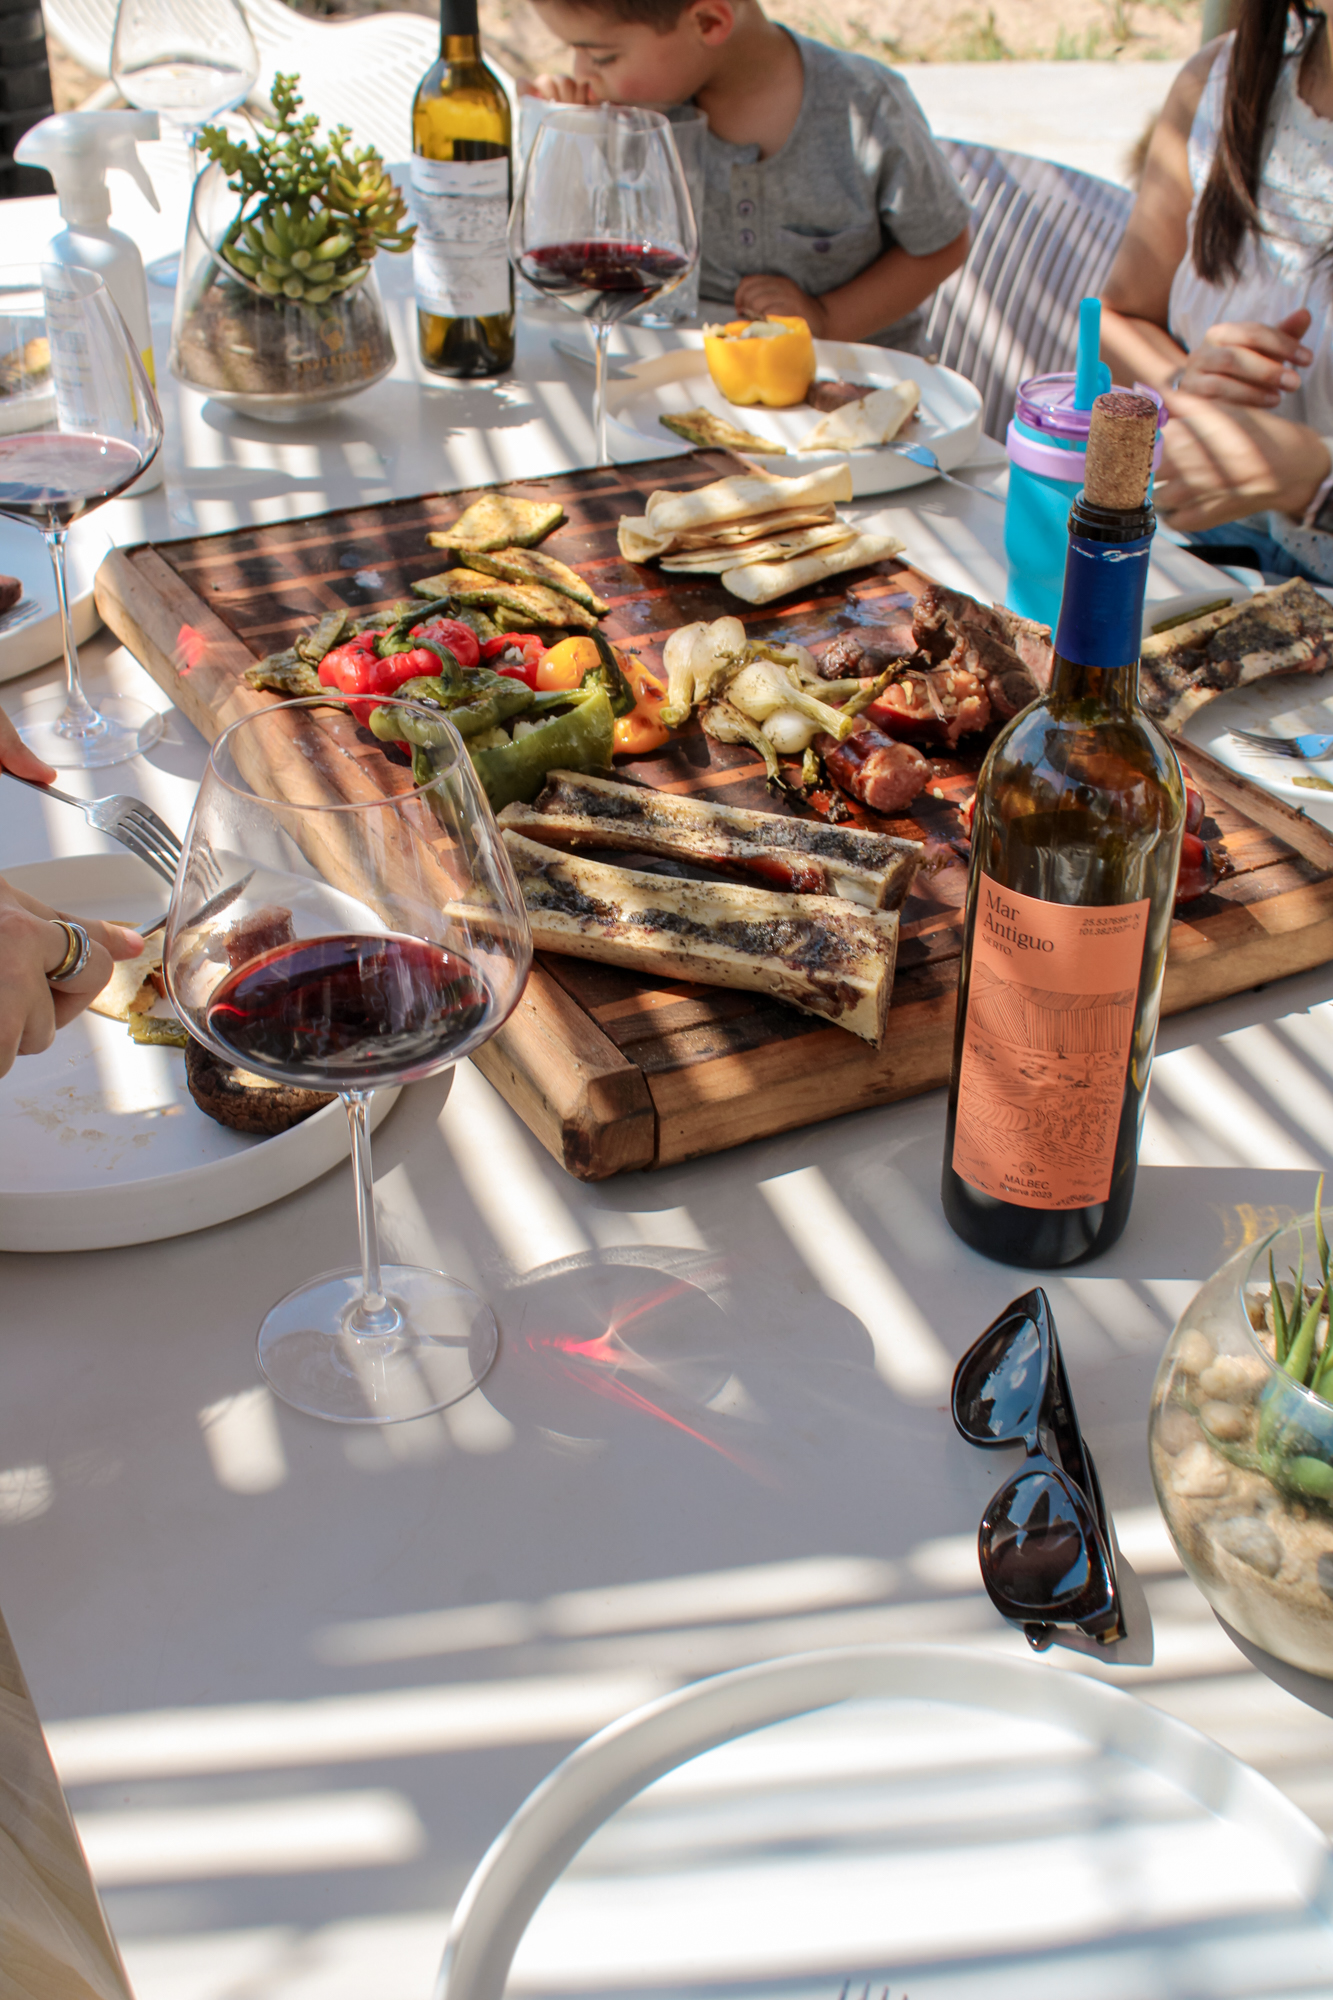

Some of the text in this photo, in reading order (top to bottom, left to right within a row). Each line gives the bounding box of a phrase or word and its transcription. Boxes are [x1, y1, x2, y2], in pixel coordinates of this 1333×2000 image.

[985, 889, 1020, 922] Mar
[983, 912, 1054, 953] Antiguo
[1004, 1173, 1050, 1190] MALBEC
